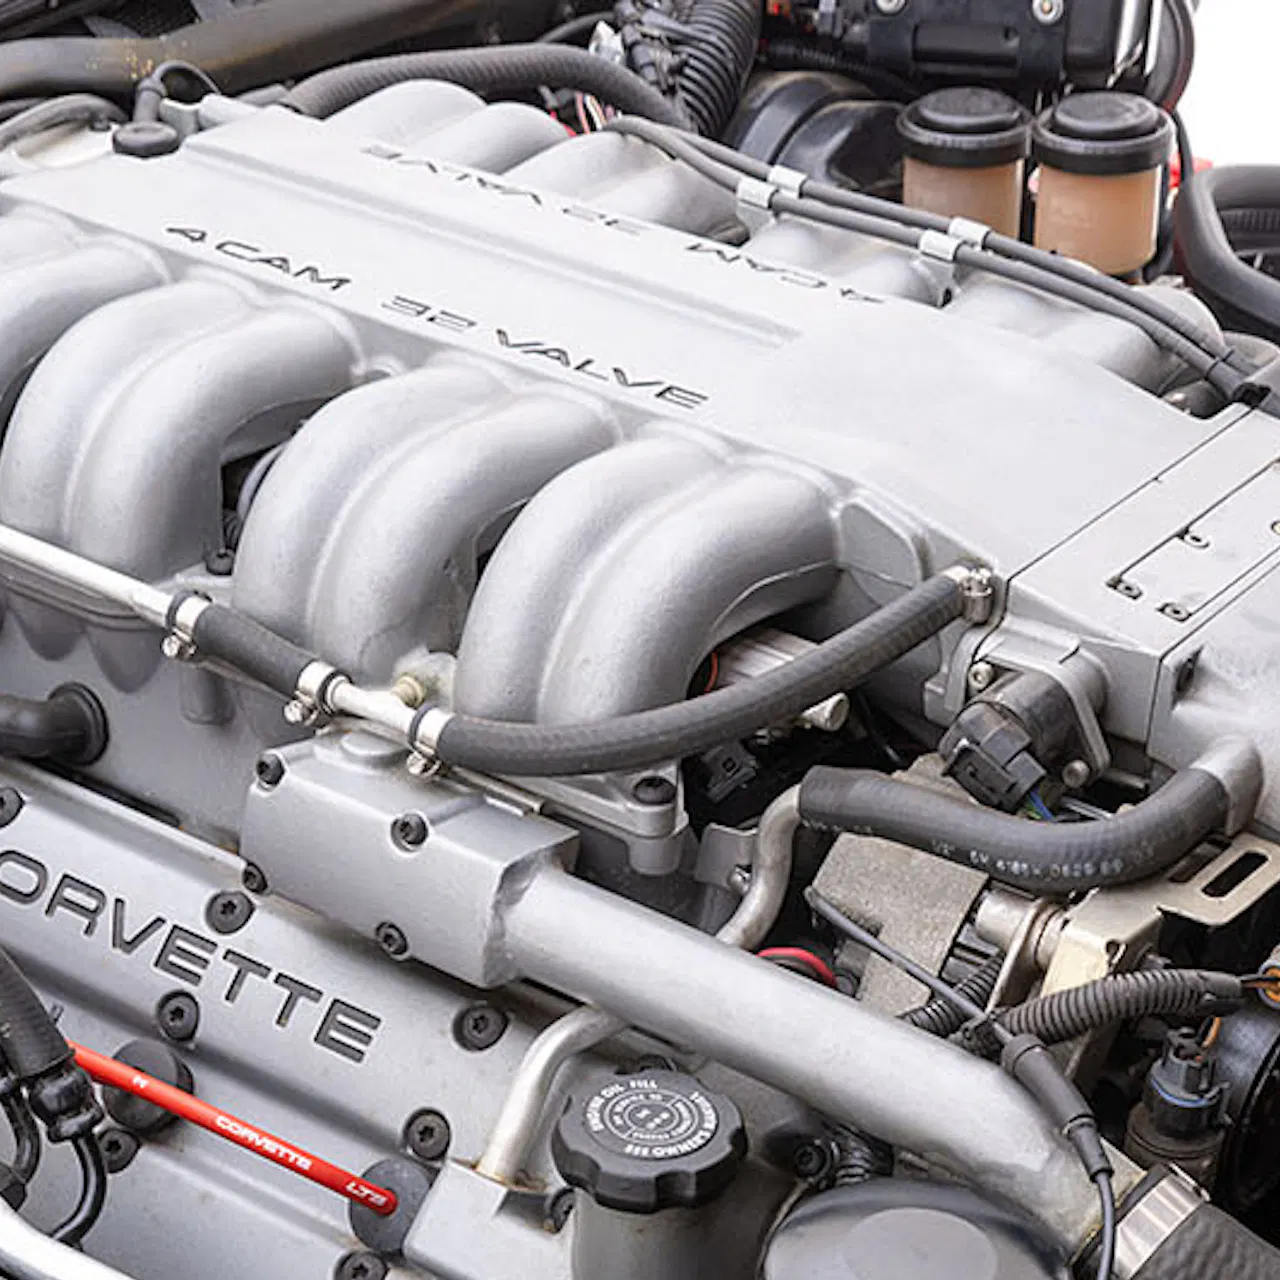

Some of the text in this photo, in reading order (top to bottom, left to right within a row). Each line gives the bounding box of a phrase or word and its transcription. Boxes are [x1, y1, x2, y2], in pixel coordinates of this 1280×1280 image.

[380, 294, 478, 333] 32
[495, 328, 710, 409] VALVE
[215, 1114, 313, 1171] CORVETTE
